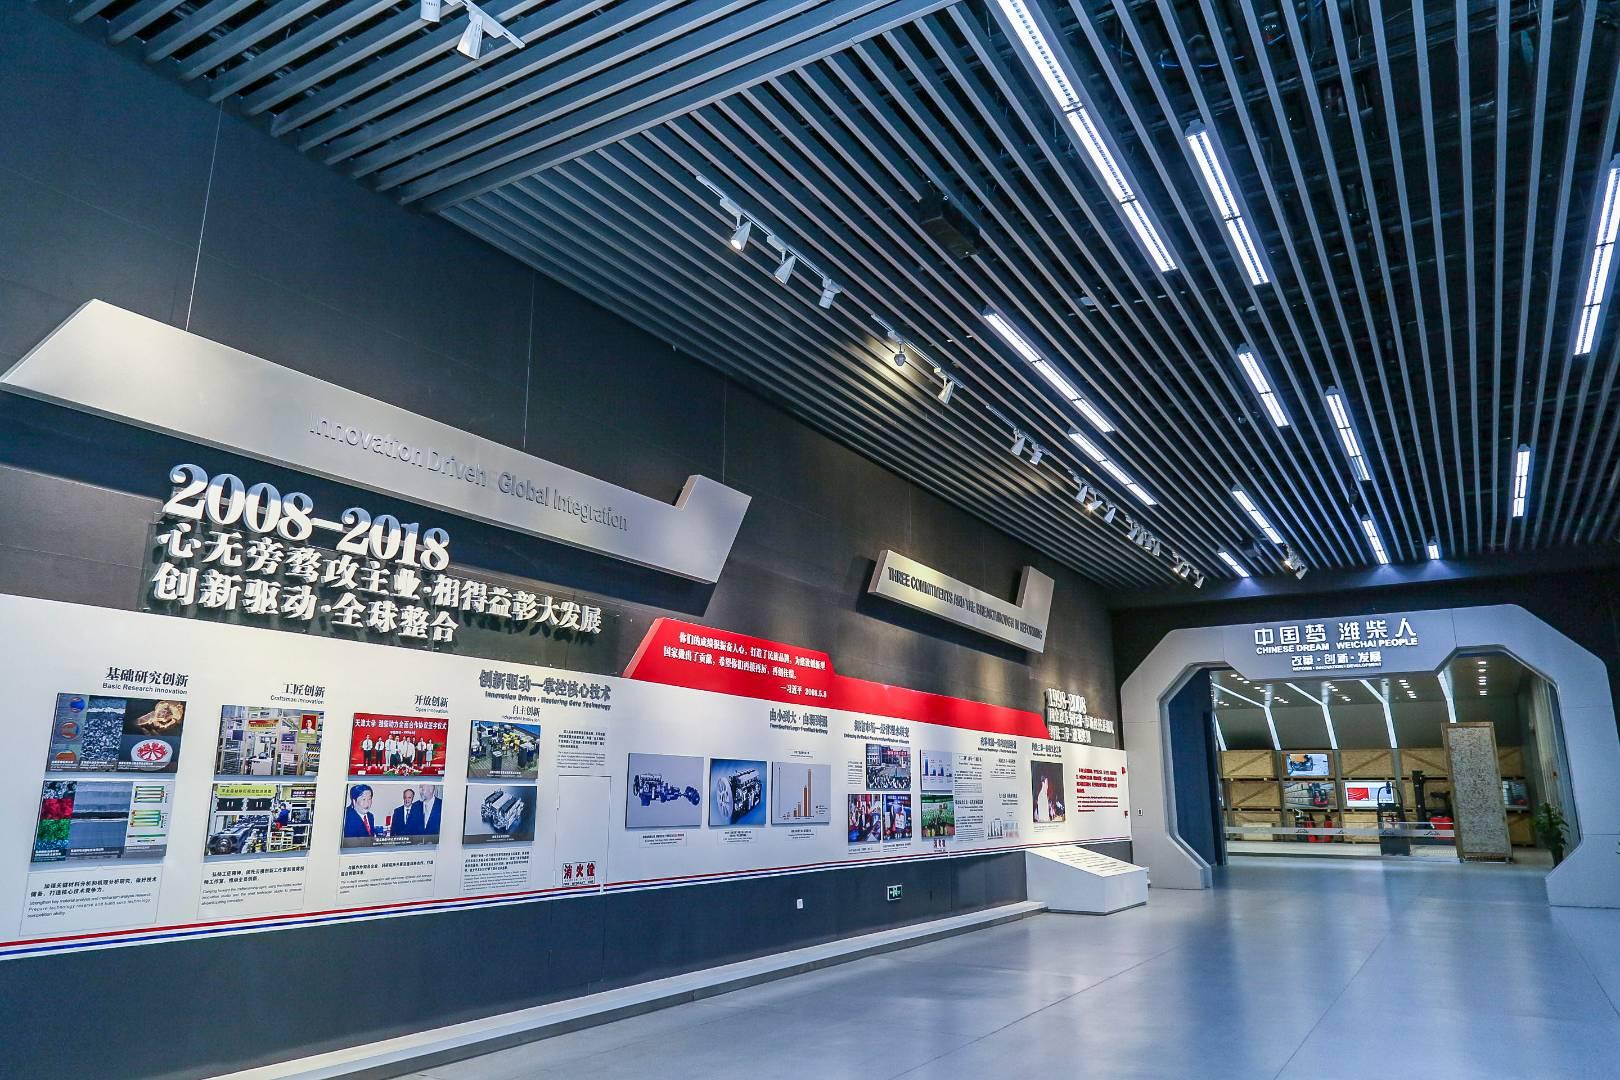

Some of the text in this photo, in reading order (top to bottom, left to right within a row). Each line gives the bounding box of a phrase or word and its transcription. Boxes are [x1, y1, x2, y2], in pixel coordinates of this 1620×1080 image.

[309, 412, 628, 532] Innovation Driven Global Integration
[887, 566, 911, 587] THREE
[152, 562, 459, 642] 创新驱动·全球整合
[1254, 617, 1417, 646] 中国梦 潍柴人
[1256, 637, 1418, 655] CHINESE DREAM WEICHAI PEOPLE
[105, 666, 189, 688] 基础研究创新
[102, 682, 121, 690] Basic
[122, 683, 153, 693] Research
[282, 683, 326, 698] 工匠创新
[485, 690, 517, 700] Innovation
[414, 694, 449, 708] 开放创新
